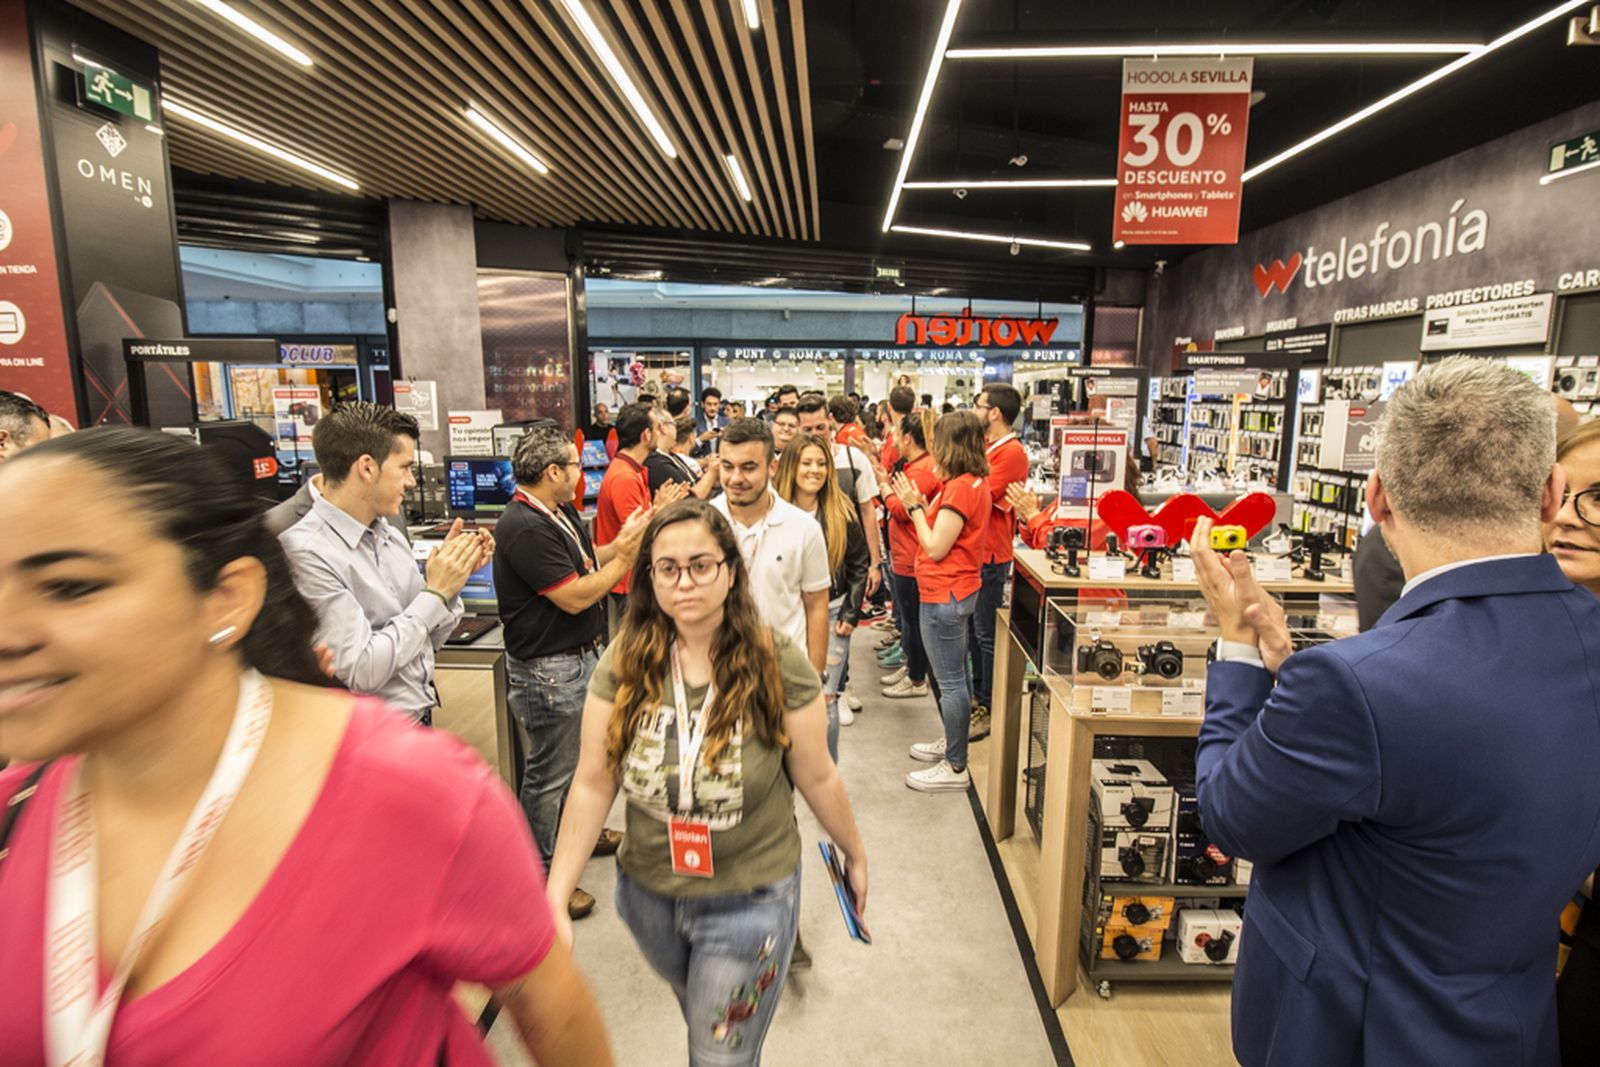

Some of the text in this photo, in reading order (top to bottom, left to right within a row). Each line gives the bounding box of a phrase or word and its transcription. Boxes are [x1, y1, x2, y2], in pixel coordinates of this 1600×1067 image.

[1127, 71, 1248, 84] HOOOLA SEVILLA
[1129, 102, 1168, 112] HASTA
[78, 158, 153, 196] OMEN
[1124, 170, 1227, 185] DESCUENTO
[1135, 191, 1193, 201] Smartphones
[1152, 206, 1208, 217] HUAWEI
[1303, 199, 1488, 289] telefonía
[1558, 269, 1600, 290] CAR
[1425, 279, 1536, 309] PROTECTORES
[1334, 297, 1419, 323] OTRAS MARCAS
[131, 344, 190, 356] PORTÁTILES
[735, 349, 822, 360] PUNT ROMA
[878, 350, 963, 360] PUNT ROMA
[1034, 351, 1063, 361] PUNT
[1187, 356, 1246, 365] SMARTPHONES
